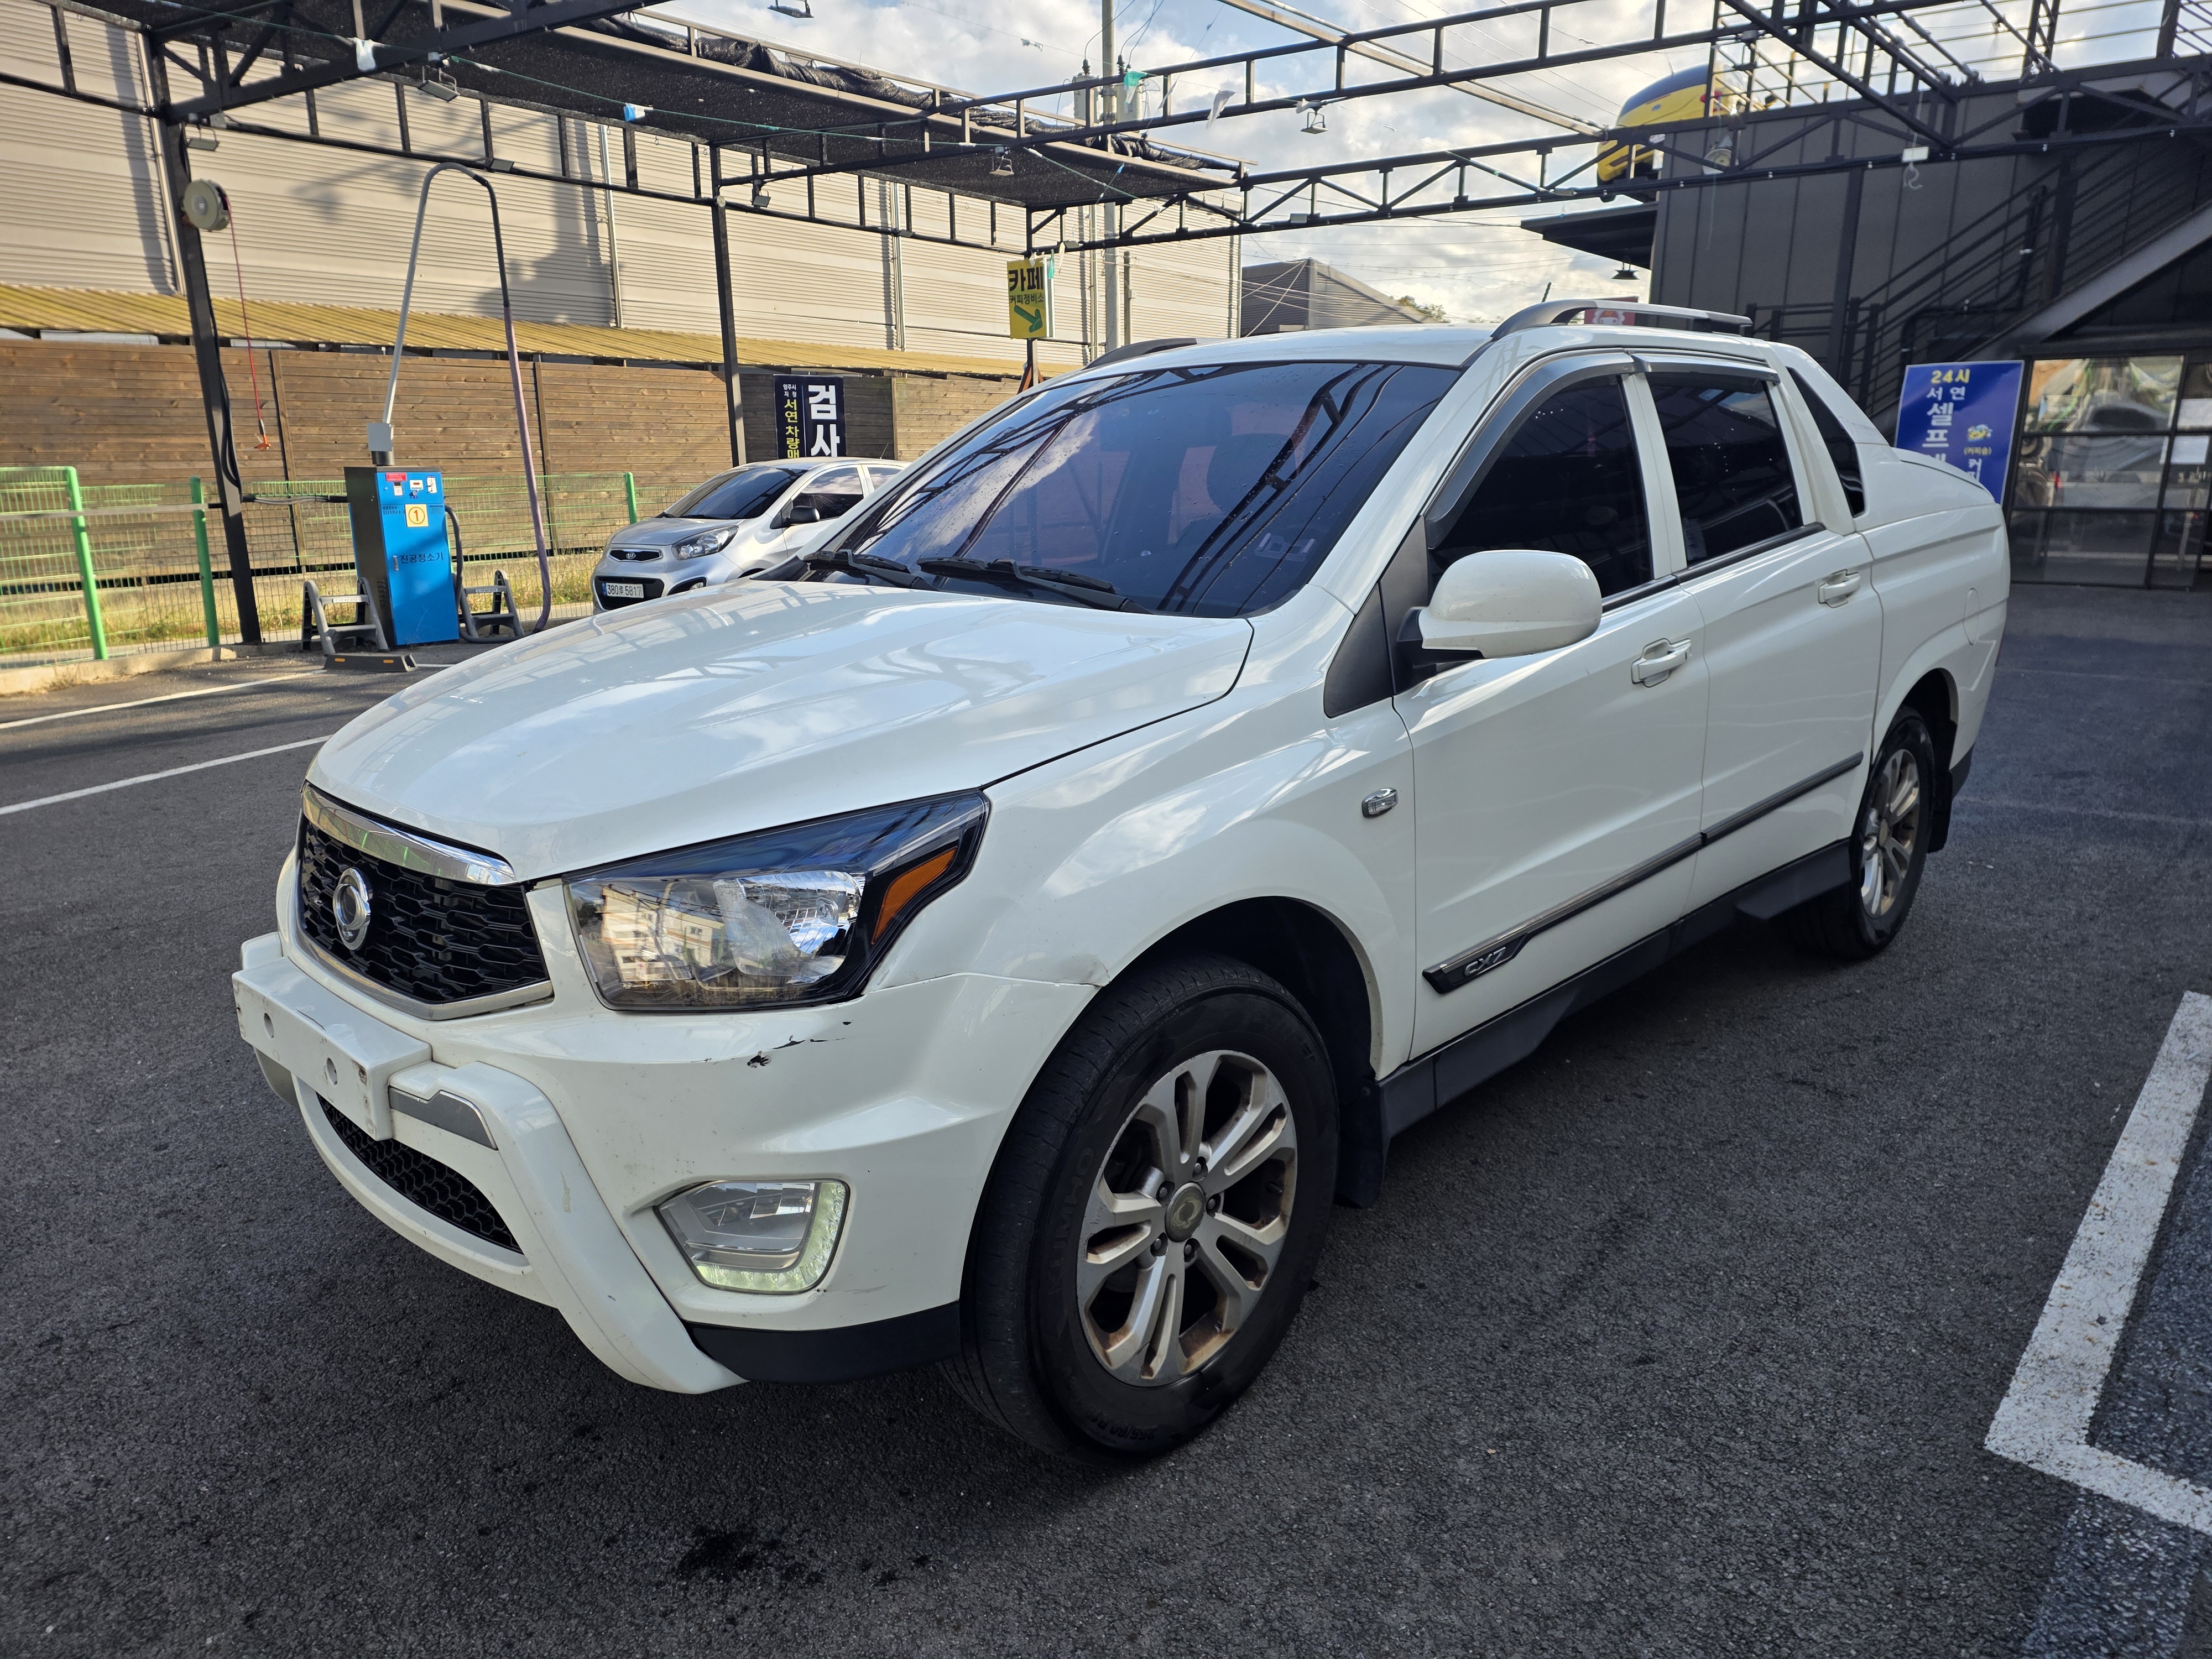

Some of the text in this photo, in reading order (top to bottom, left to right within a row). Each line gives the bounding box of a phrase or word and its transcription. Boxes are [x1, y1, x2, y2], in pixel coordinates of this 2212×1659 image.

[1009, 267, 1044, 292] 카페
[1010, 293, 1045, 305] 커피정비소
[1931, 368, 1970, 384] 24시
[808, 385, 840, 457] 검사
[400, 552, 444, 564] 진공청소기
